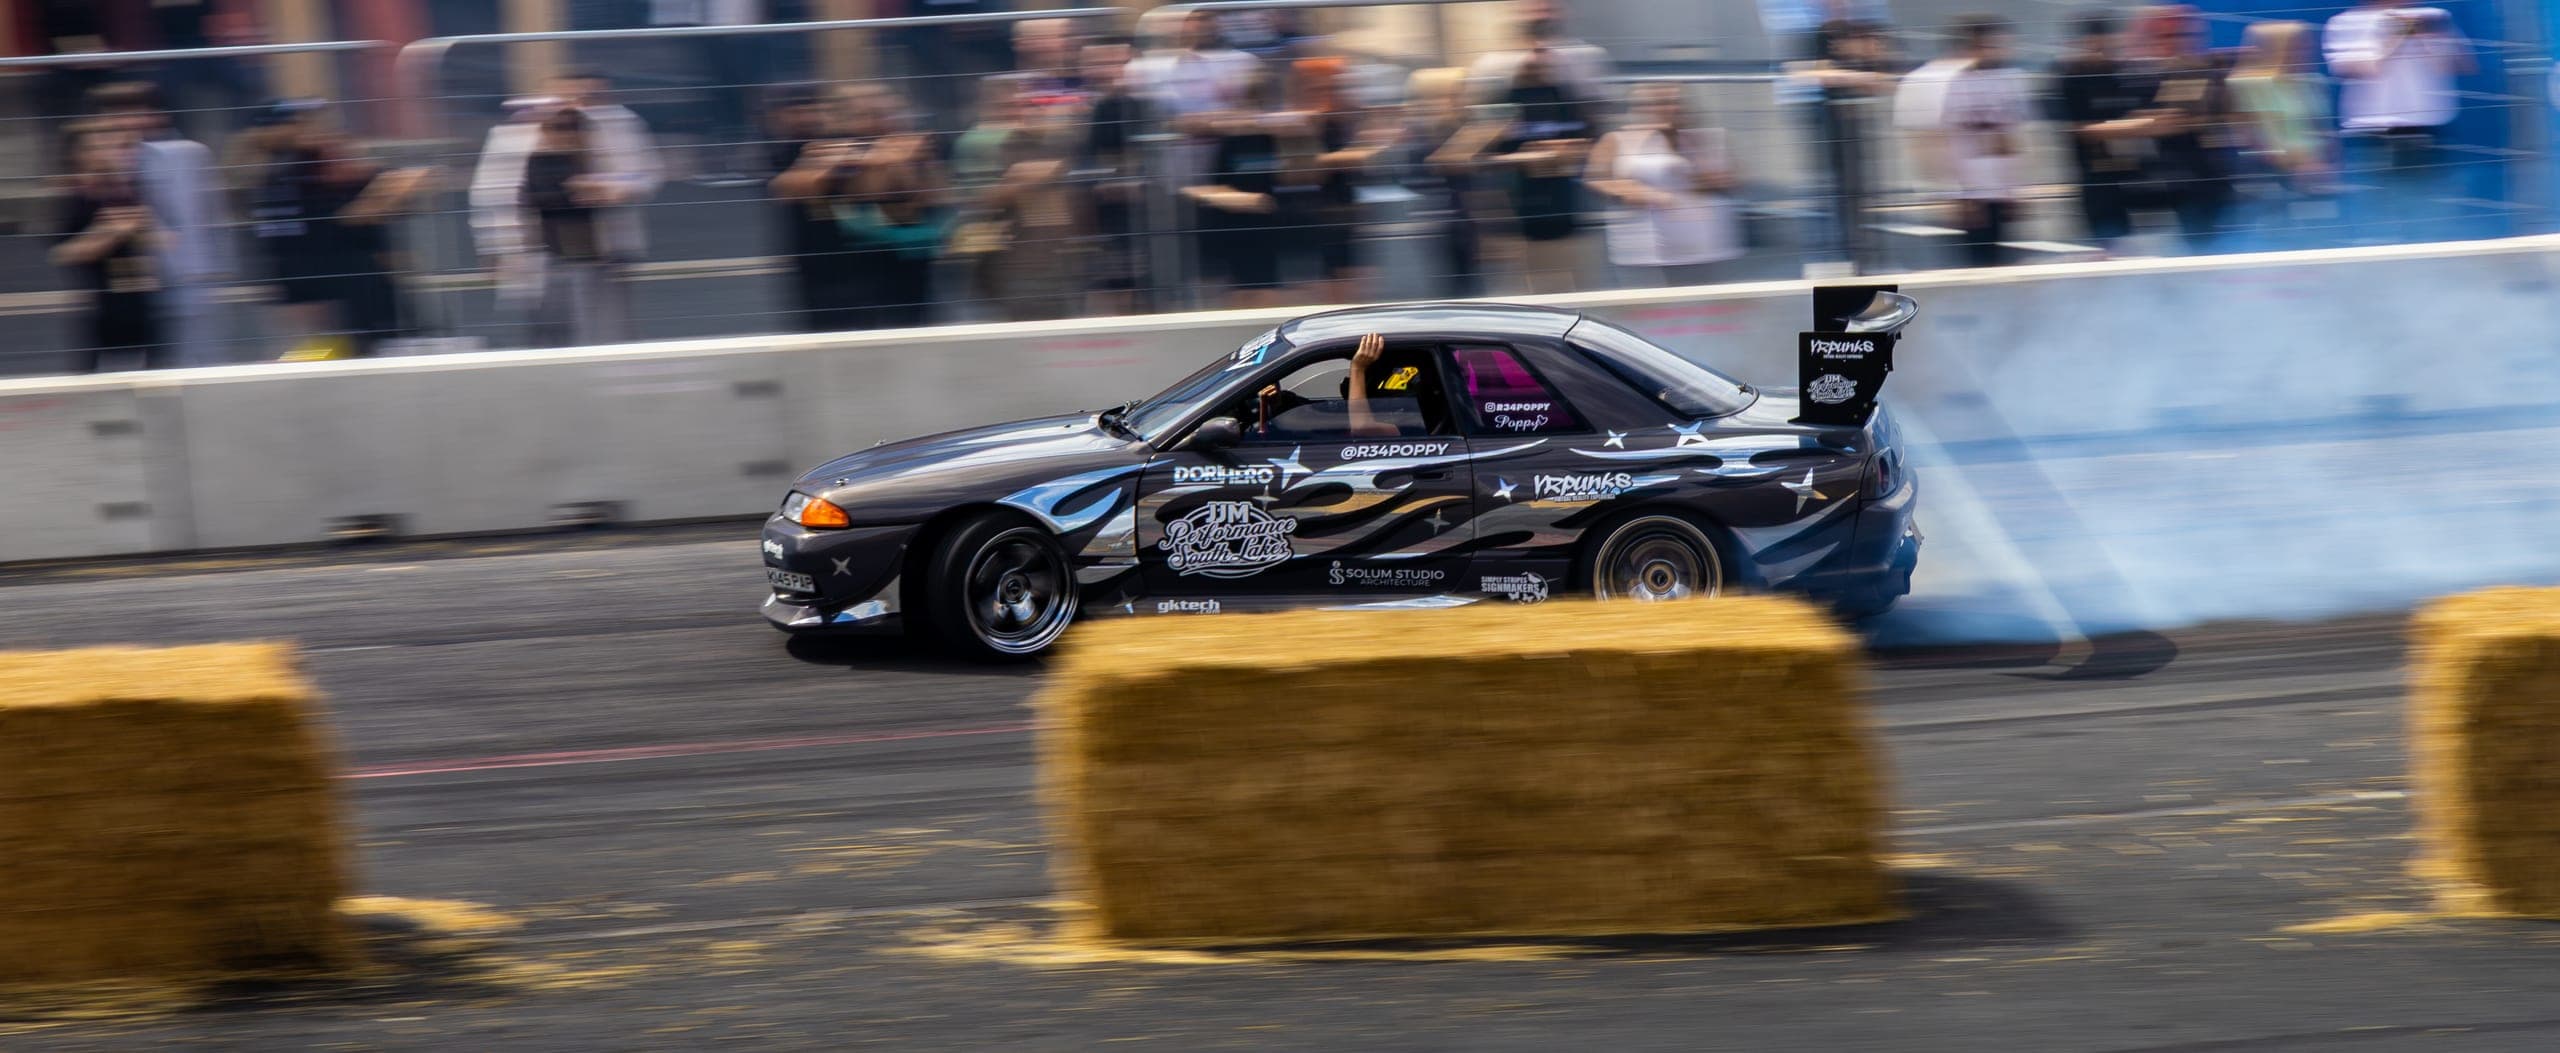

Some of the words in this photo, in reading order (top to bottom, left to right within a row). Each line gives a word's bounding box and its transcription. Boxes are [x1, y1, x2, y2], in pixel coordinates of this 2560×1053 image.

[1496, 403, 1551, 411] R34POPPY
[1494, 414, 1542, 432] Poppy
[1341, 443, 1449, 461] @R34POPPY
[1205, 501, 1252, 523] JJM
[1158, 517, 1298, 551] Performance
[1167, 541, 1231, 570] South
[1240, 537, 1293, 563] Lakes
[1345, 568, 1393, 579] SOLUM
[1395, 569, 1446, 581] STUDIO
[1503, 576, 1528, 584] STRIPES
[1360, 579, 1432, 587] ARCHITECTURE
[1480, 583, 1541, 593] SIGNMAKERS
[1157, 599, 1221, 614] gktech
